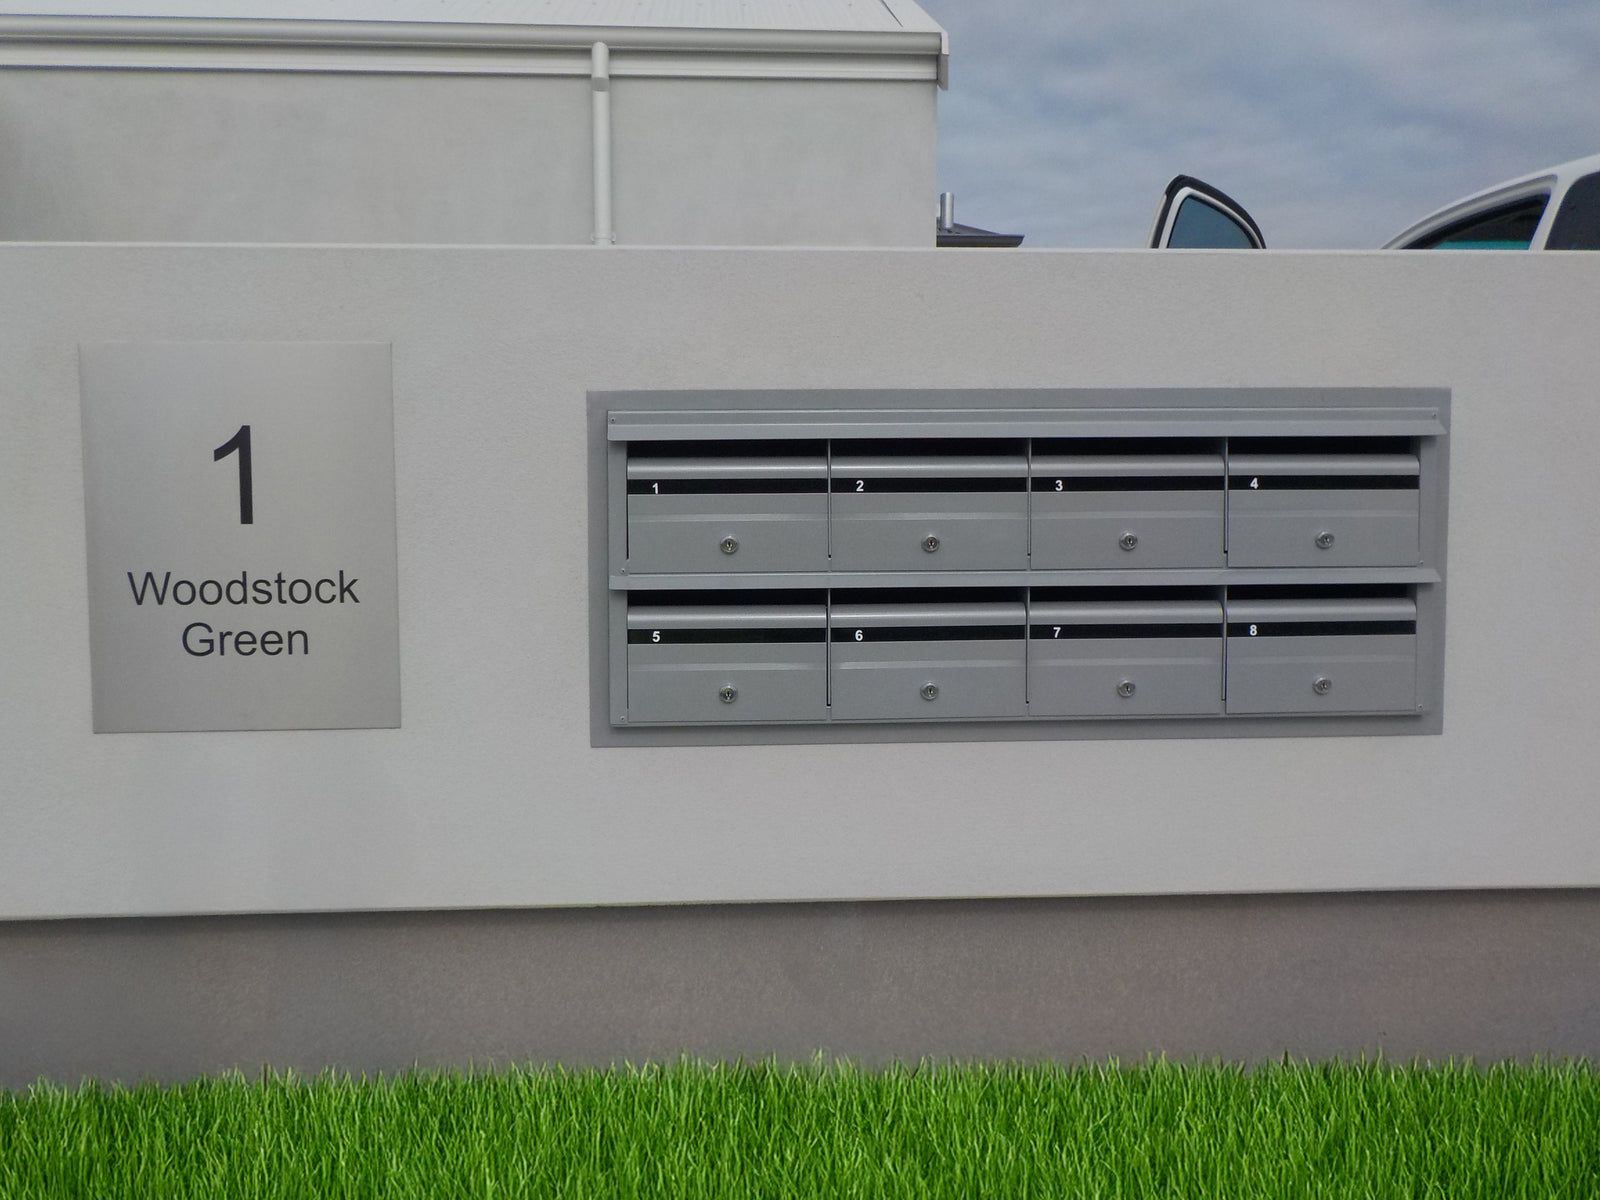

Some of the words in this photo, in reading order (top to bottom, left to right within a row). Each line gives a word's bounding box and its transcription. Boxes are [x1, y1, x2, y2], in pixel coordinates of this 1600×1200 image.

[213, 424, 254, 525] 1
[651, 482, 659, 495] 1
[855, 479, 864, 492] 2
[1055, 479, 1064, 492] 3
[1249, 477, 1259, 489] 4
[127, 570, 361, 606] Woodstock
[652, 630, 661, 643] 5
[854, 629, 864, 642] 6
[1053, 626, 1061, 638] 7
[1249, 624, 1258, 636] 8
[181, 621, 309, 657] Green
